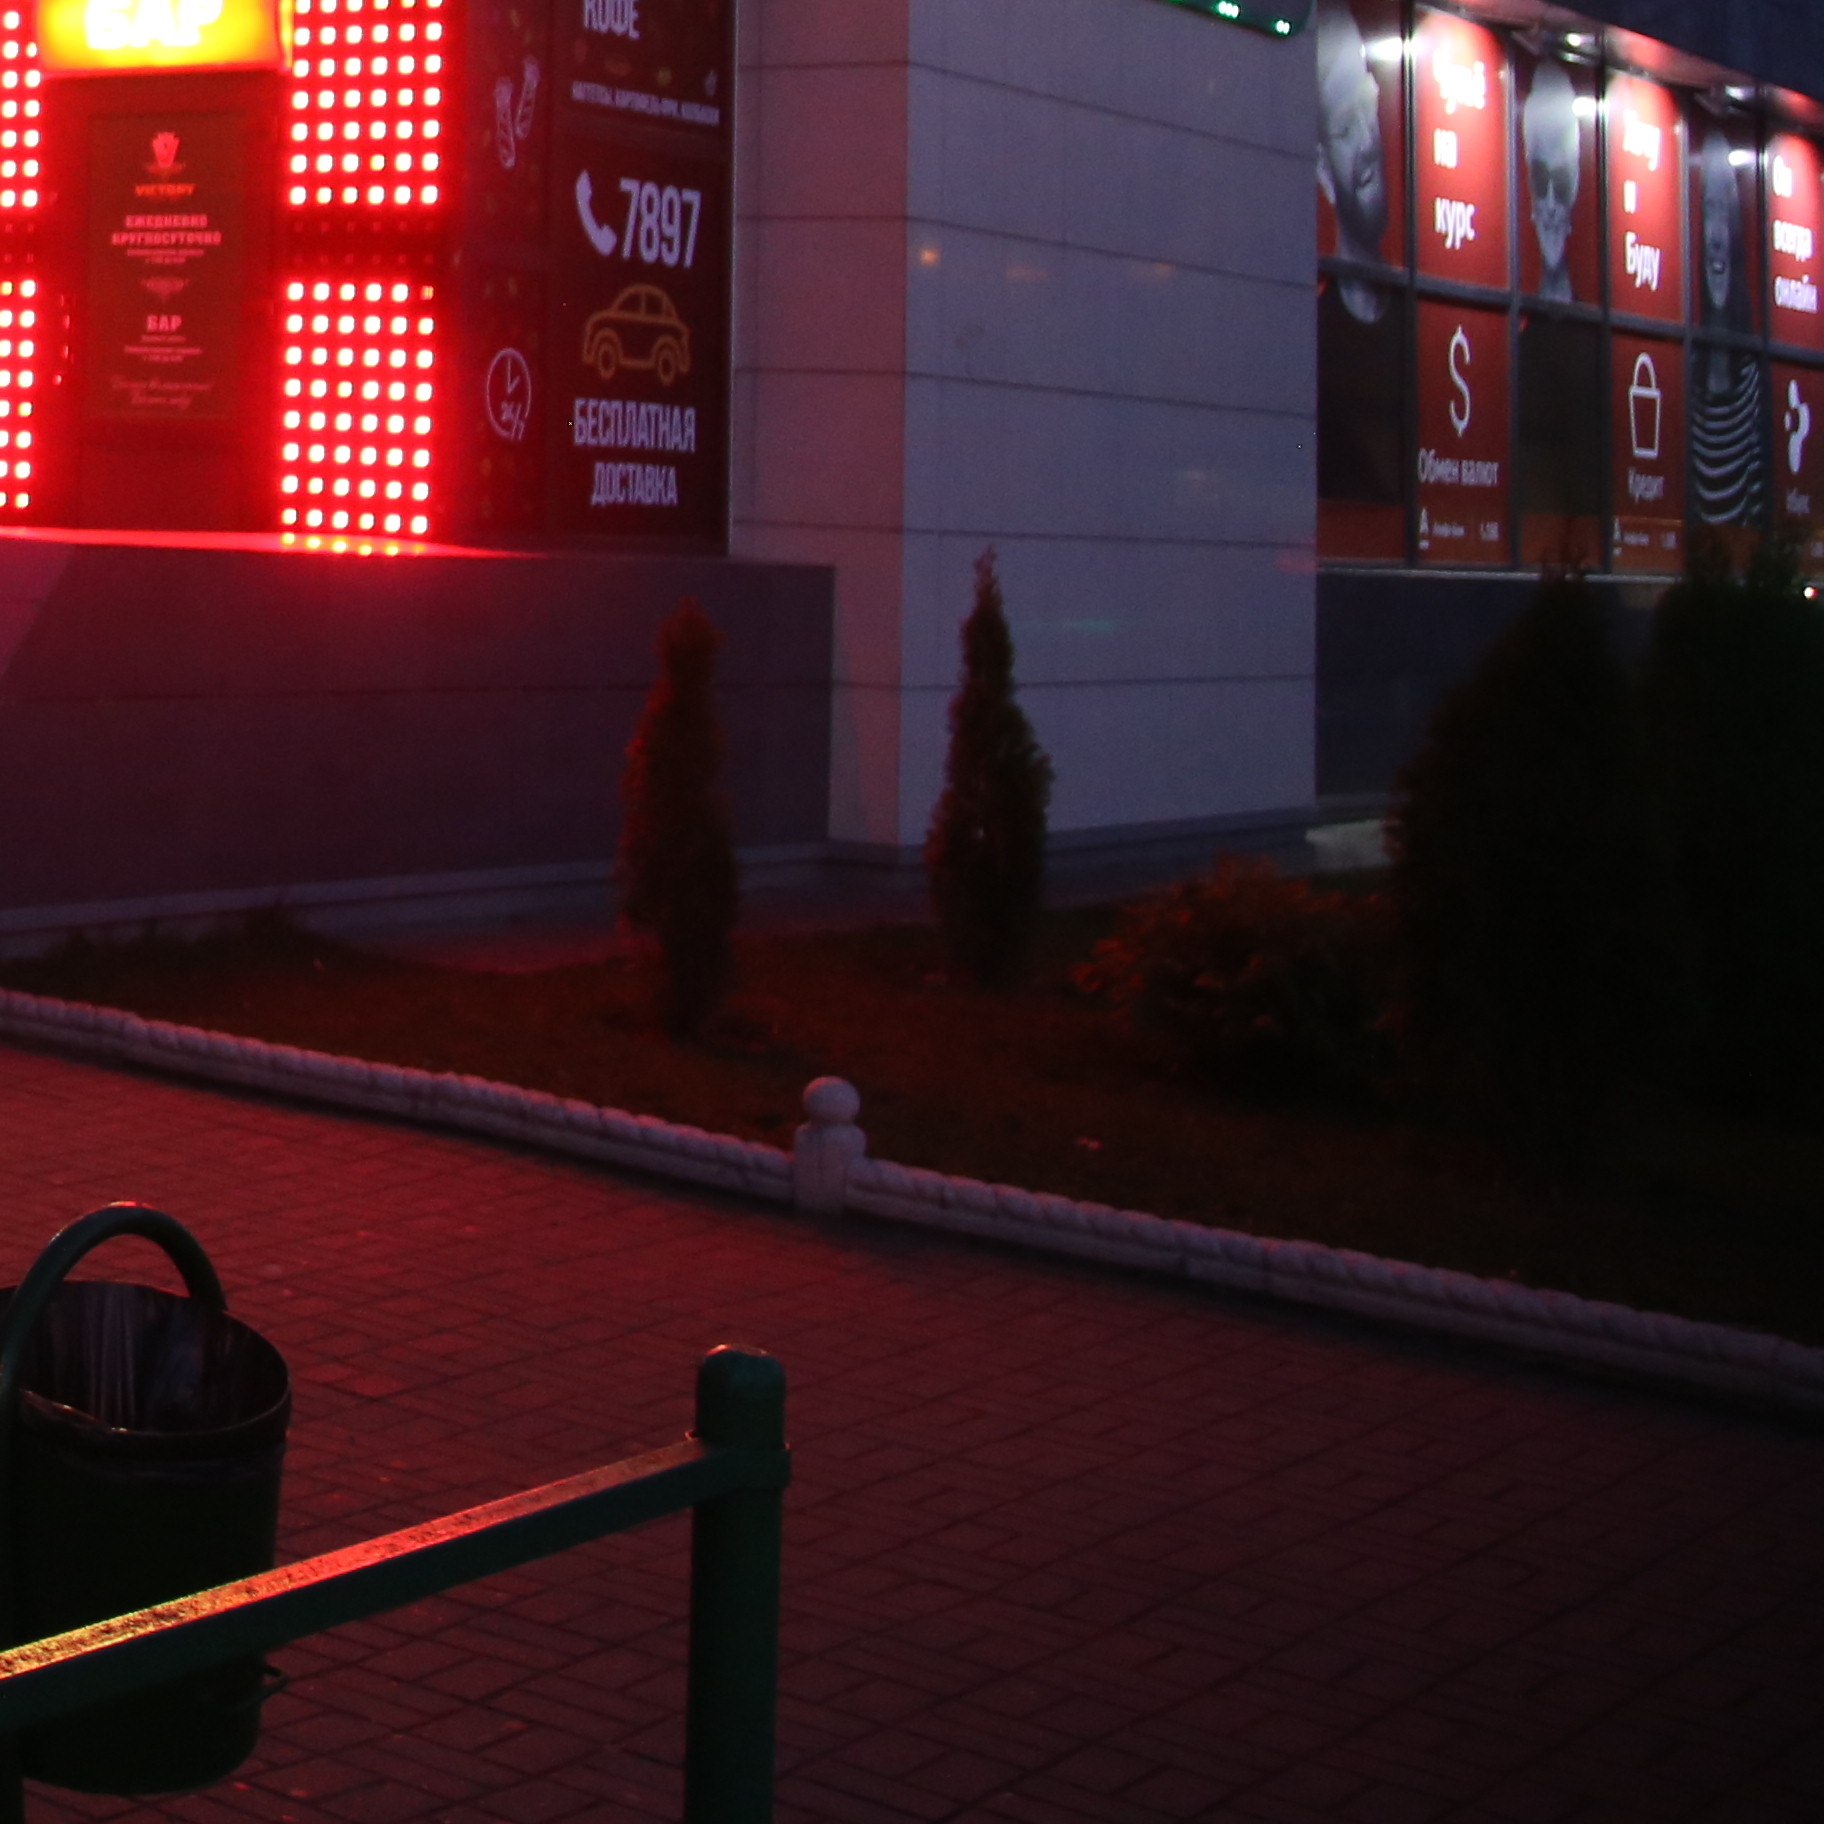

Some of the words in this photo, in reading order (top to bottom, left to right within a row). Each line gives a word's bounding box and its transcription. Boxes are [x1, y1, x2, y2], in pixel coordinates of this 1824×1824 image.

[618, 177, 703, 269] 7897
[1435, 196, 1476, 250] курс
[146, 314, 184, 333] БАР
[573, 396, 697, 455] БЕСПЛАТНАЯ
[589, 461, 680, 508] ДОСТАВКА
